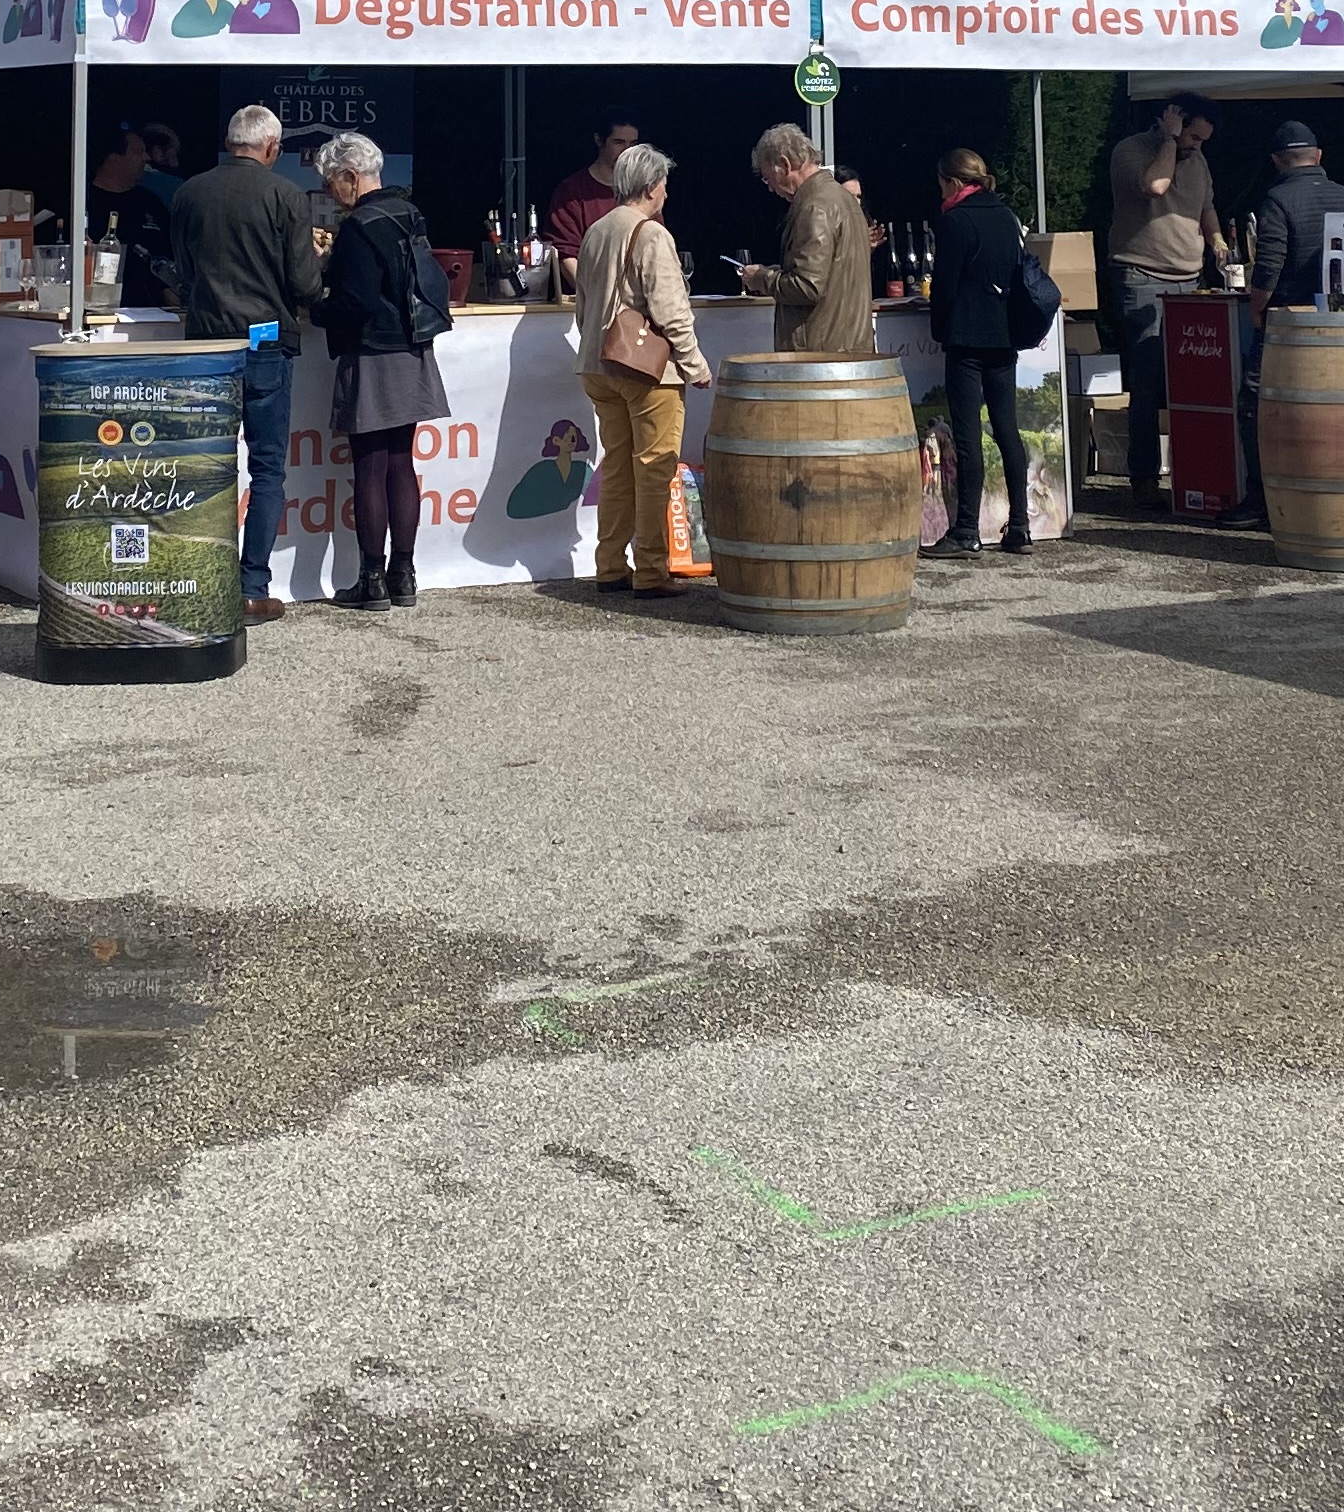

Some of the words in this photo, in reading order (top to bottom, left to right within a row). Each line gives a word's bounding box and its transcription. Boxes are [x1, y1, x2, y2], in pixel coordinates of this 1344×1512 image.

[634, 6, 648, 15] -
[273, 82, 335, 96] CHÂTEAU
[339, 85, 365, 96] DES
[90, 385, 111, 400] IGP
[113, 382, 168, 402] ARDÈCHE
[78, 455, 112, 478] Les
[123, 451, 179, 479] Vins
[65, 478, 196, 511] d'Ardèche
[65, 579, 197, 597] LESVINSDARDECHE.COM
